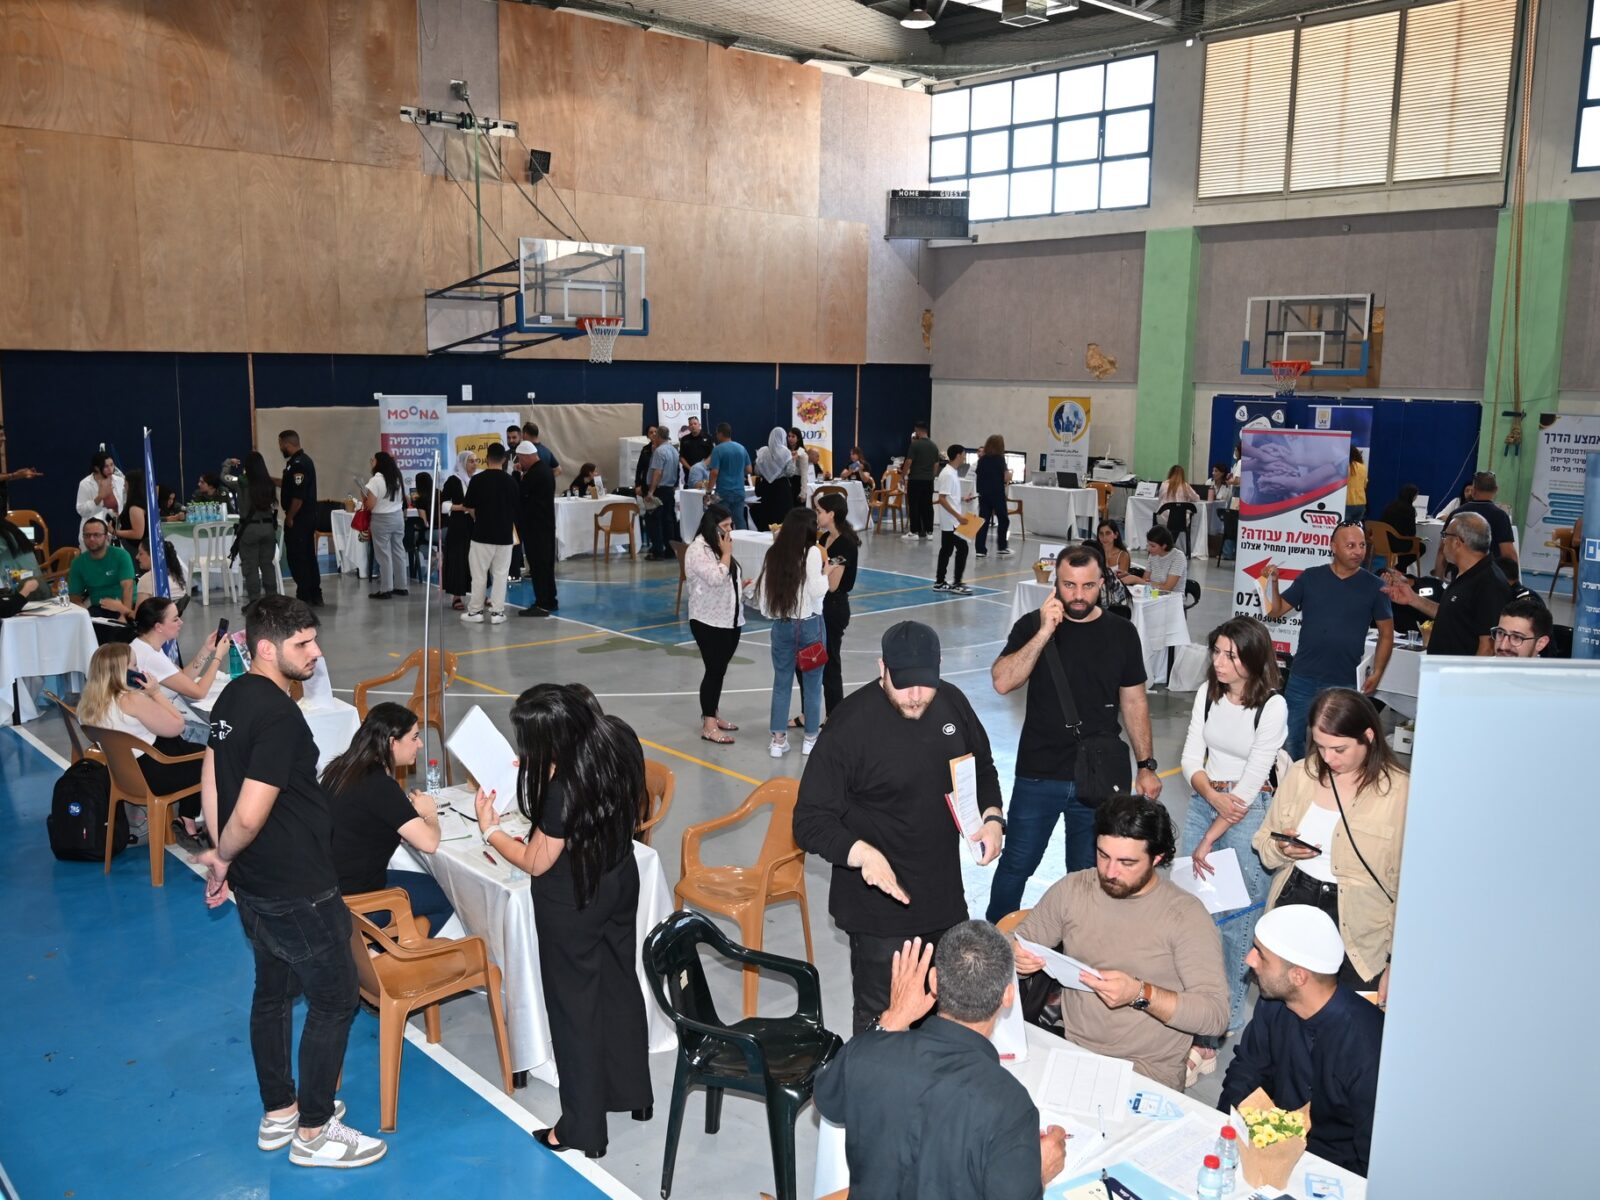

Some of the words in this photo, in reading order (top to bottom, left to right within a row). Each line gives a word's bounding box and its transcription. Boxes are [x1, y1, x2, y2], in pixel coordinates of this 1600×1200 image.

[661, 398, 699, 412] babcom
[388, 406, 439, 419] MOONA
[389, 436, 439, 445] האקדמיה
[1544, 432, 1571, 445] הדרך
[1549, 446, 1563, 455] שלך
[397, 457, 433, 469] להייטק
[1550, 456, 1571, 465] קריירה
[1561, 465, 1572, 473] גיל
[1306, 513, 1337, 525] אתגר
[1241, 526, 1282, 542] עבודה?
[1285, 531, 1333, 547] חפש/ת
[1240, 541, 1261, 551] אצלנו
[1263, 542, 1286, 553] מתחיל
[1288, 546, 1315, 556] הראשון
[1318, 548, 1335, 558] צעד
